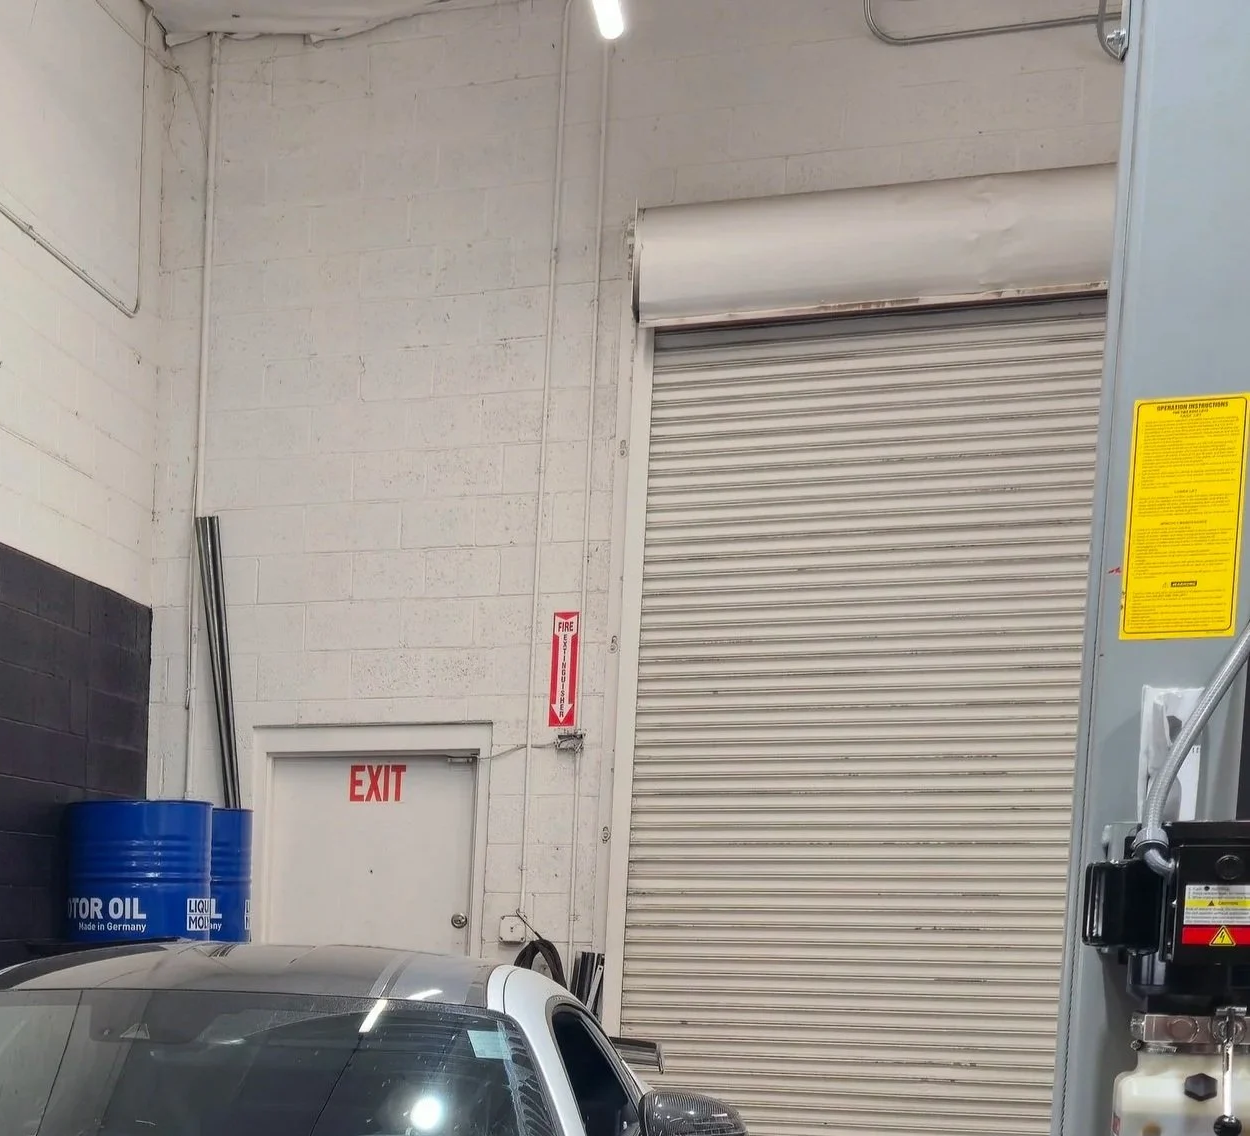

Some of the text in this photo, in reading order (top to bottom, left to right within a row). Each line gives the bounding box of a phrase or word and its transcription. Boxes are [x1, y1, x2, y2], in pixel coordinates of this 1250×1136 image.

[558, 621, 573, 632] FIRE
[559, 634, 568, 717] EXTINGUISHER
[350, 764, 406, 801] EXIT
[108, 897, 146, 919] OIL
[79, 922, 147, 933] Made in Germany
